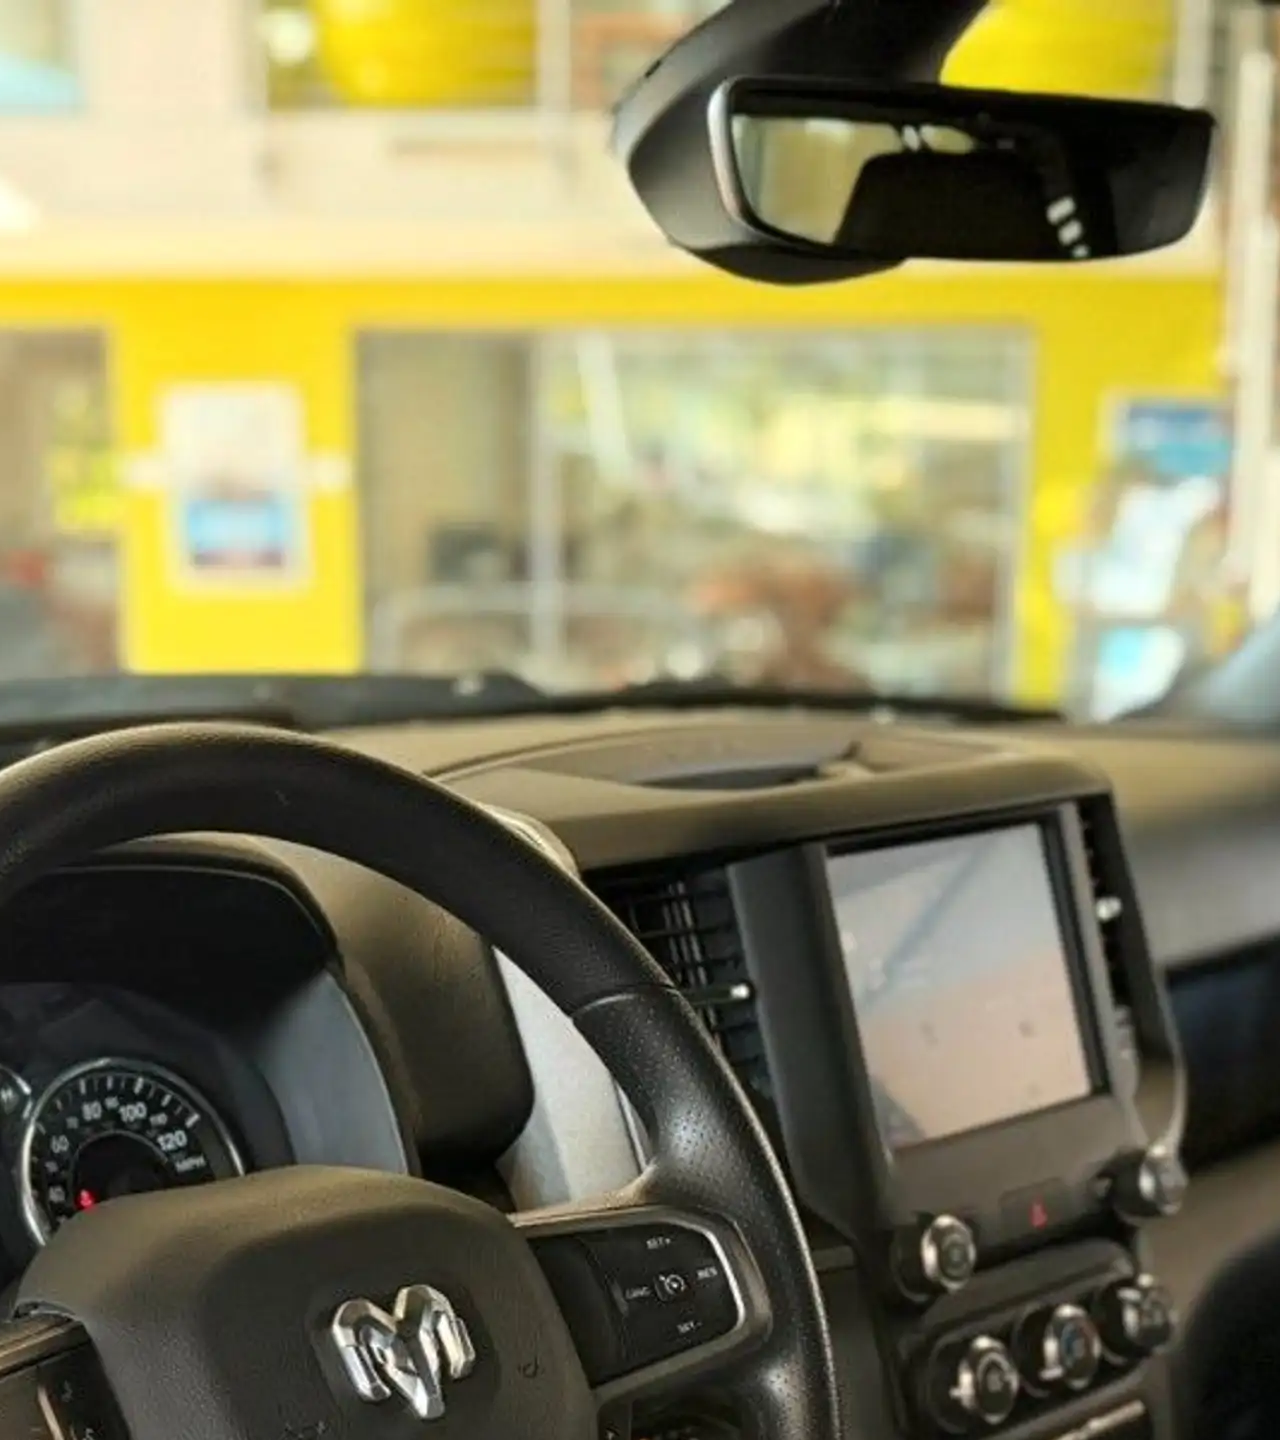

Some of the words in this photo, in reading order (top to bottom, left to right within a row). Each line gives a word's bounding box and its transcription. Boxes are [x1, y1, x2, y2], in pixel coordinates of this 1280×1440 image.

[83, 1104, 101, 1120] 80
[119, 1103, 147, 1122] 100
[52, 1137, 69, 1153] 60
[157, 1130, 187, 1151] 120
[174, 1156, 206, 1174] MPH
